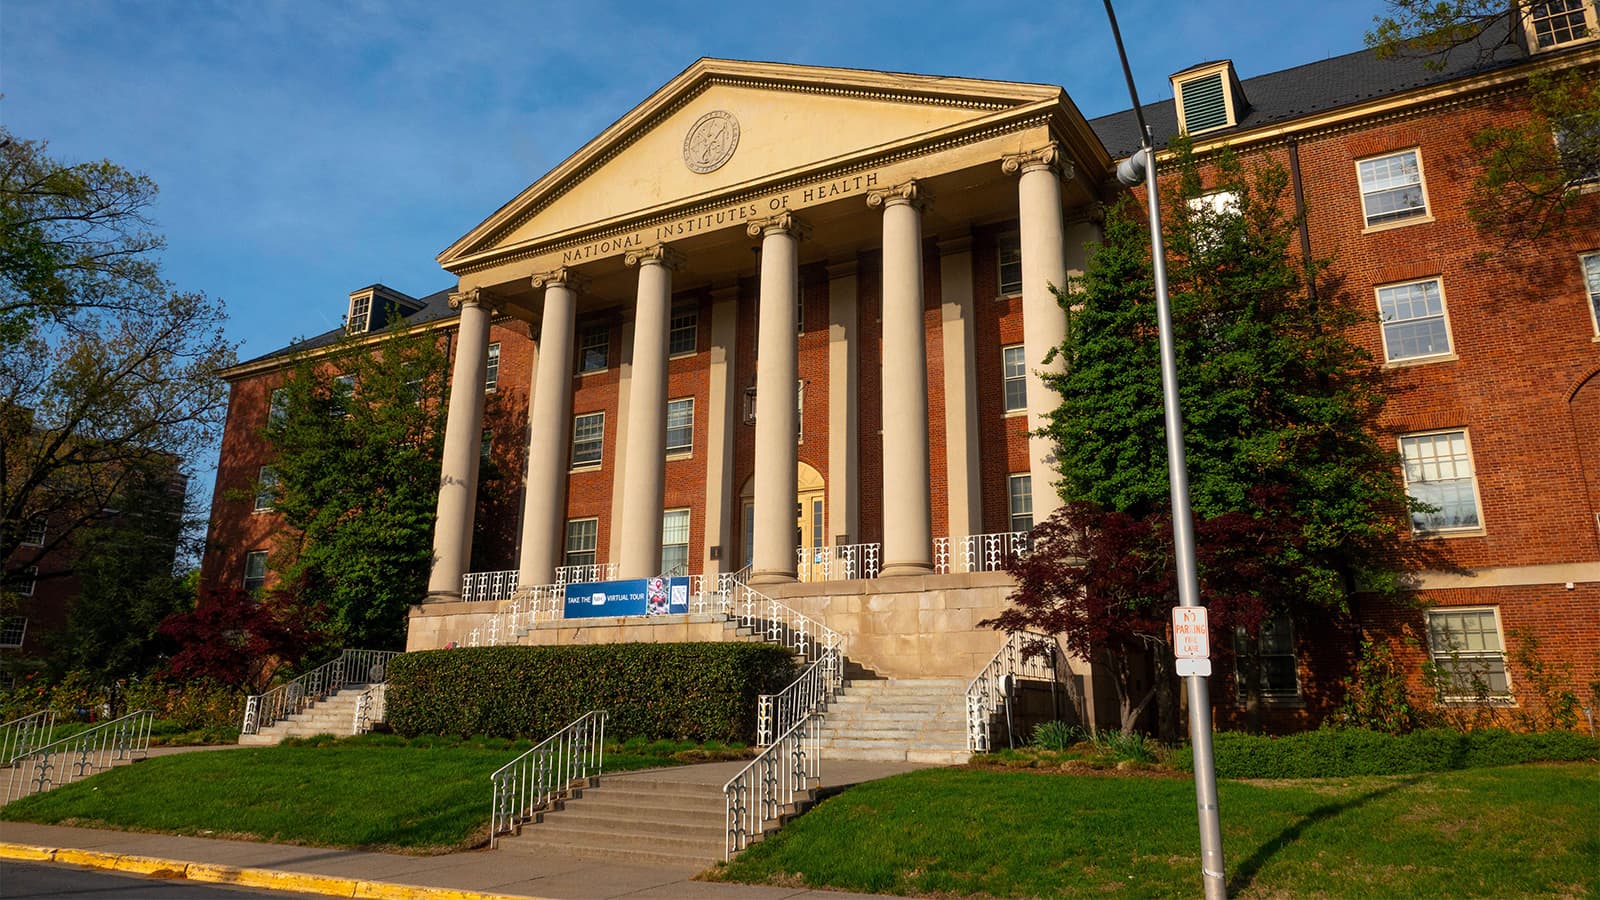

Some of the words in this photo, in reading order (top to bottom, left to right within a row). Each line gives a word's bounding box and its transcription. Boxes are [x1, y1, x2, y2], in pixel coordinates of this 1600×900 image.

[563, 234, 642, 263] NATIONAL
[656, 204, 757, 240] INSTITUTES
[769, 195, 790, 210] OF
[803, 173, 878, 202] HEALTH
[1183, 613, 1196, 622] NO
[1176, 625, 1206, 634] PARING
